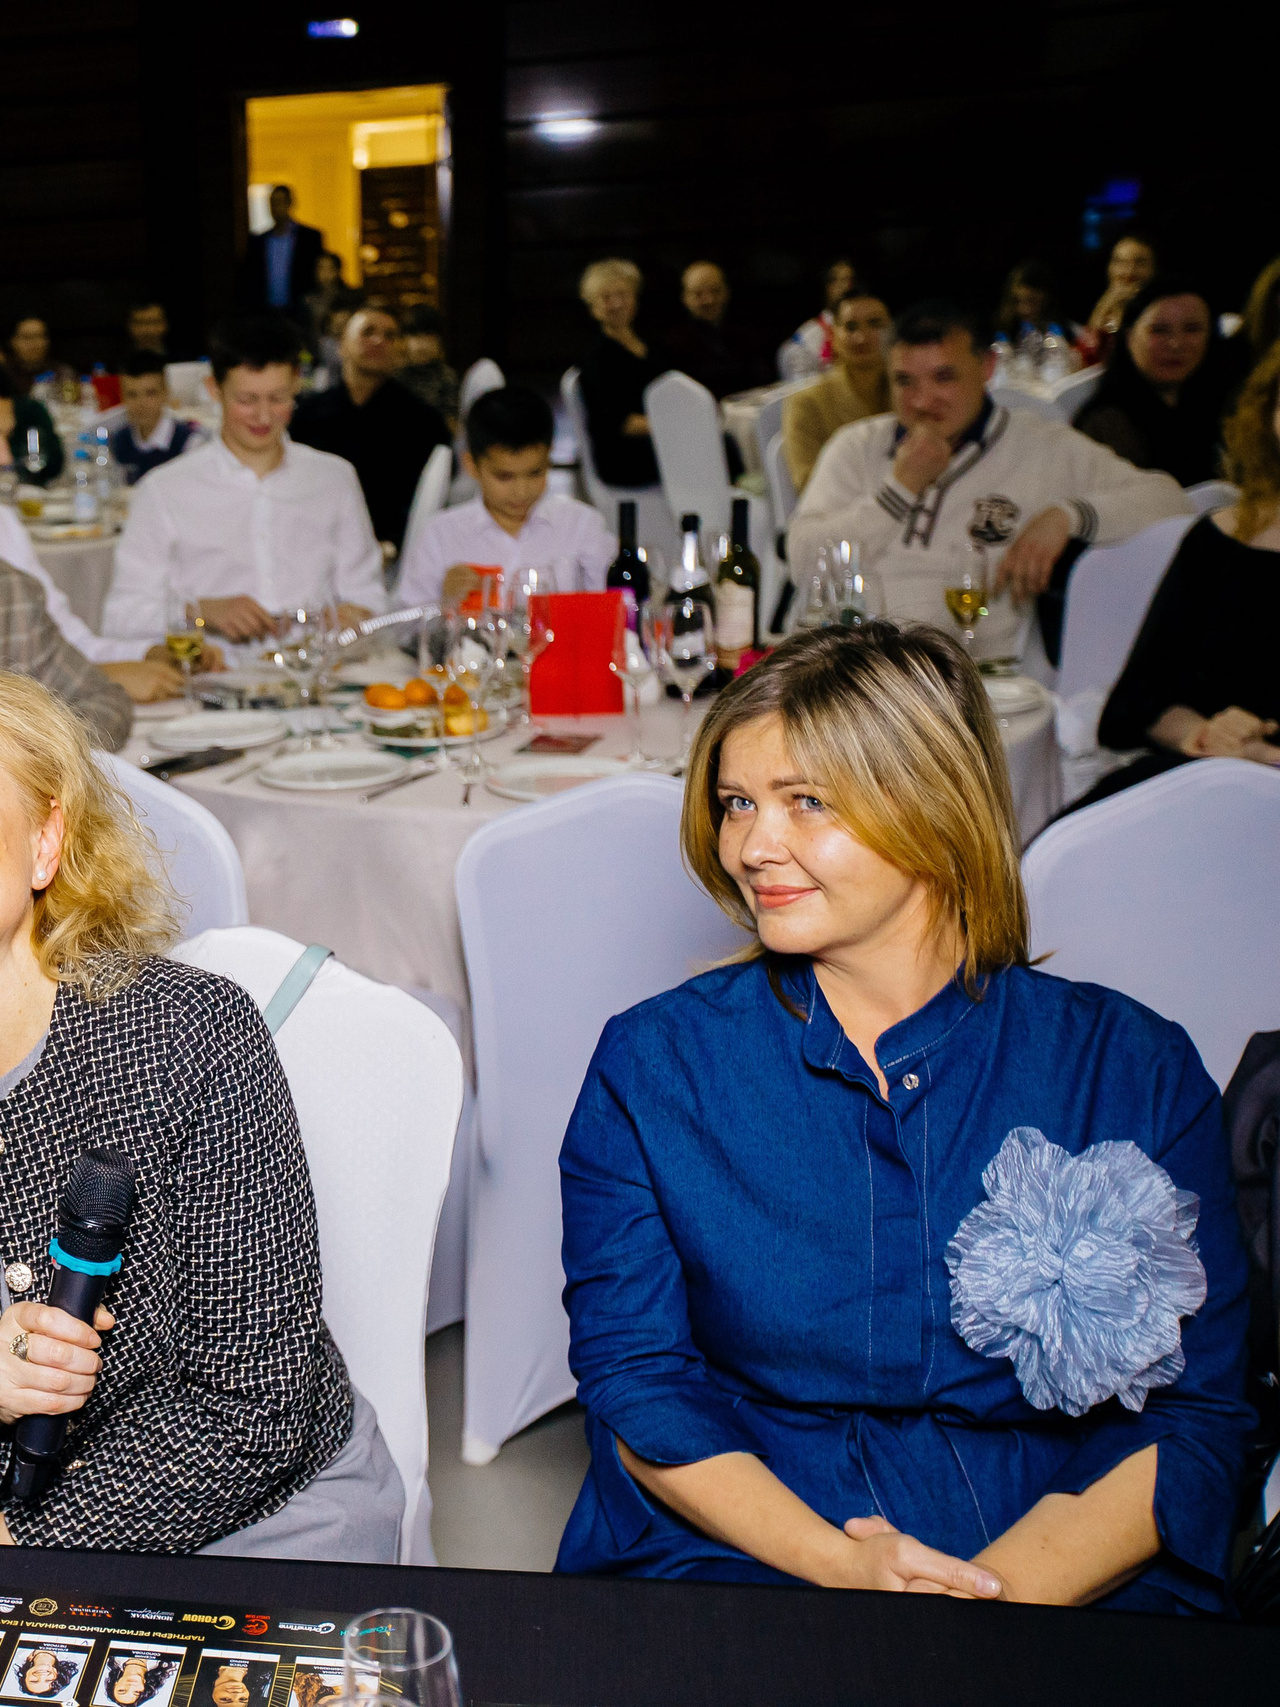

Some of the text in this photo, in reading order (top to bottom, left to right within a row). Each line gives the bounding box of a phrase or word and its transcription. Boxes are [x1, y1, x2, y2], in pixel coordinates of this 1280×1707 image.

[130, 1613, 174, 1621] MOKHNYAK
[182, 1613, 218, 1624] FOHOW
[26, 1621, 67, 1629] ФИНАЛА
[278, 1624, 322, 1632] PrimeTime
[68, 1625, 151, 1636] РЕГИОНАЛЬНОГО
[153, 1631, 206, 1641] ПАРТНЁРЫ
